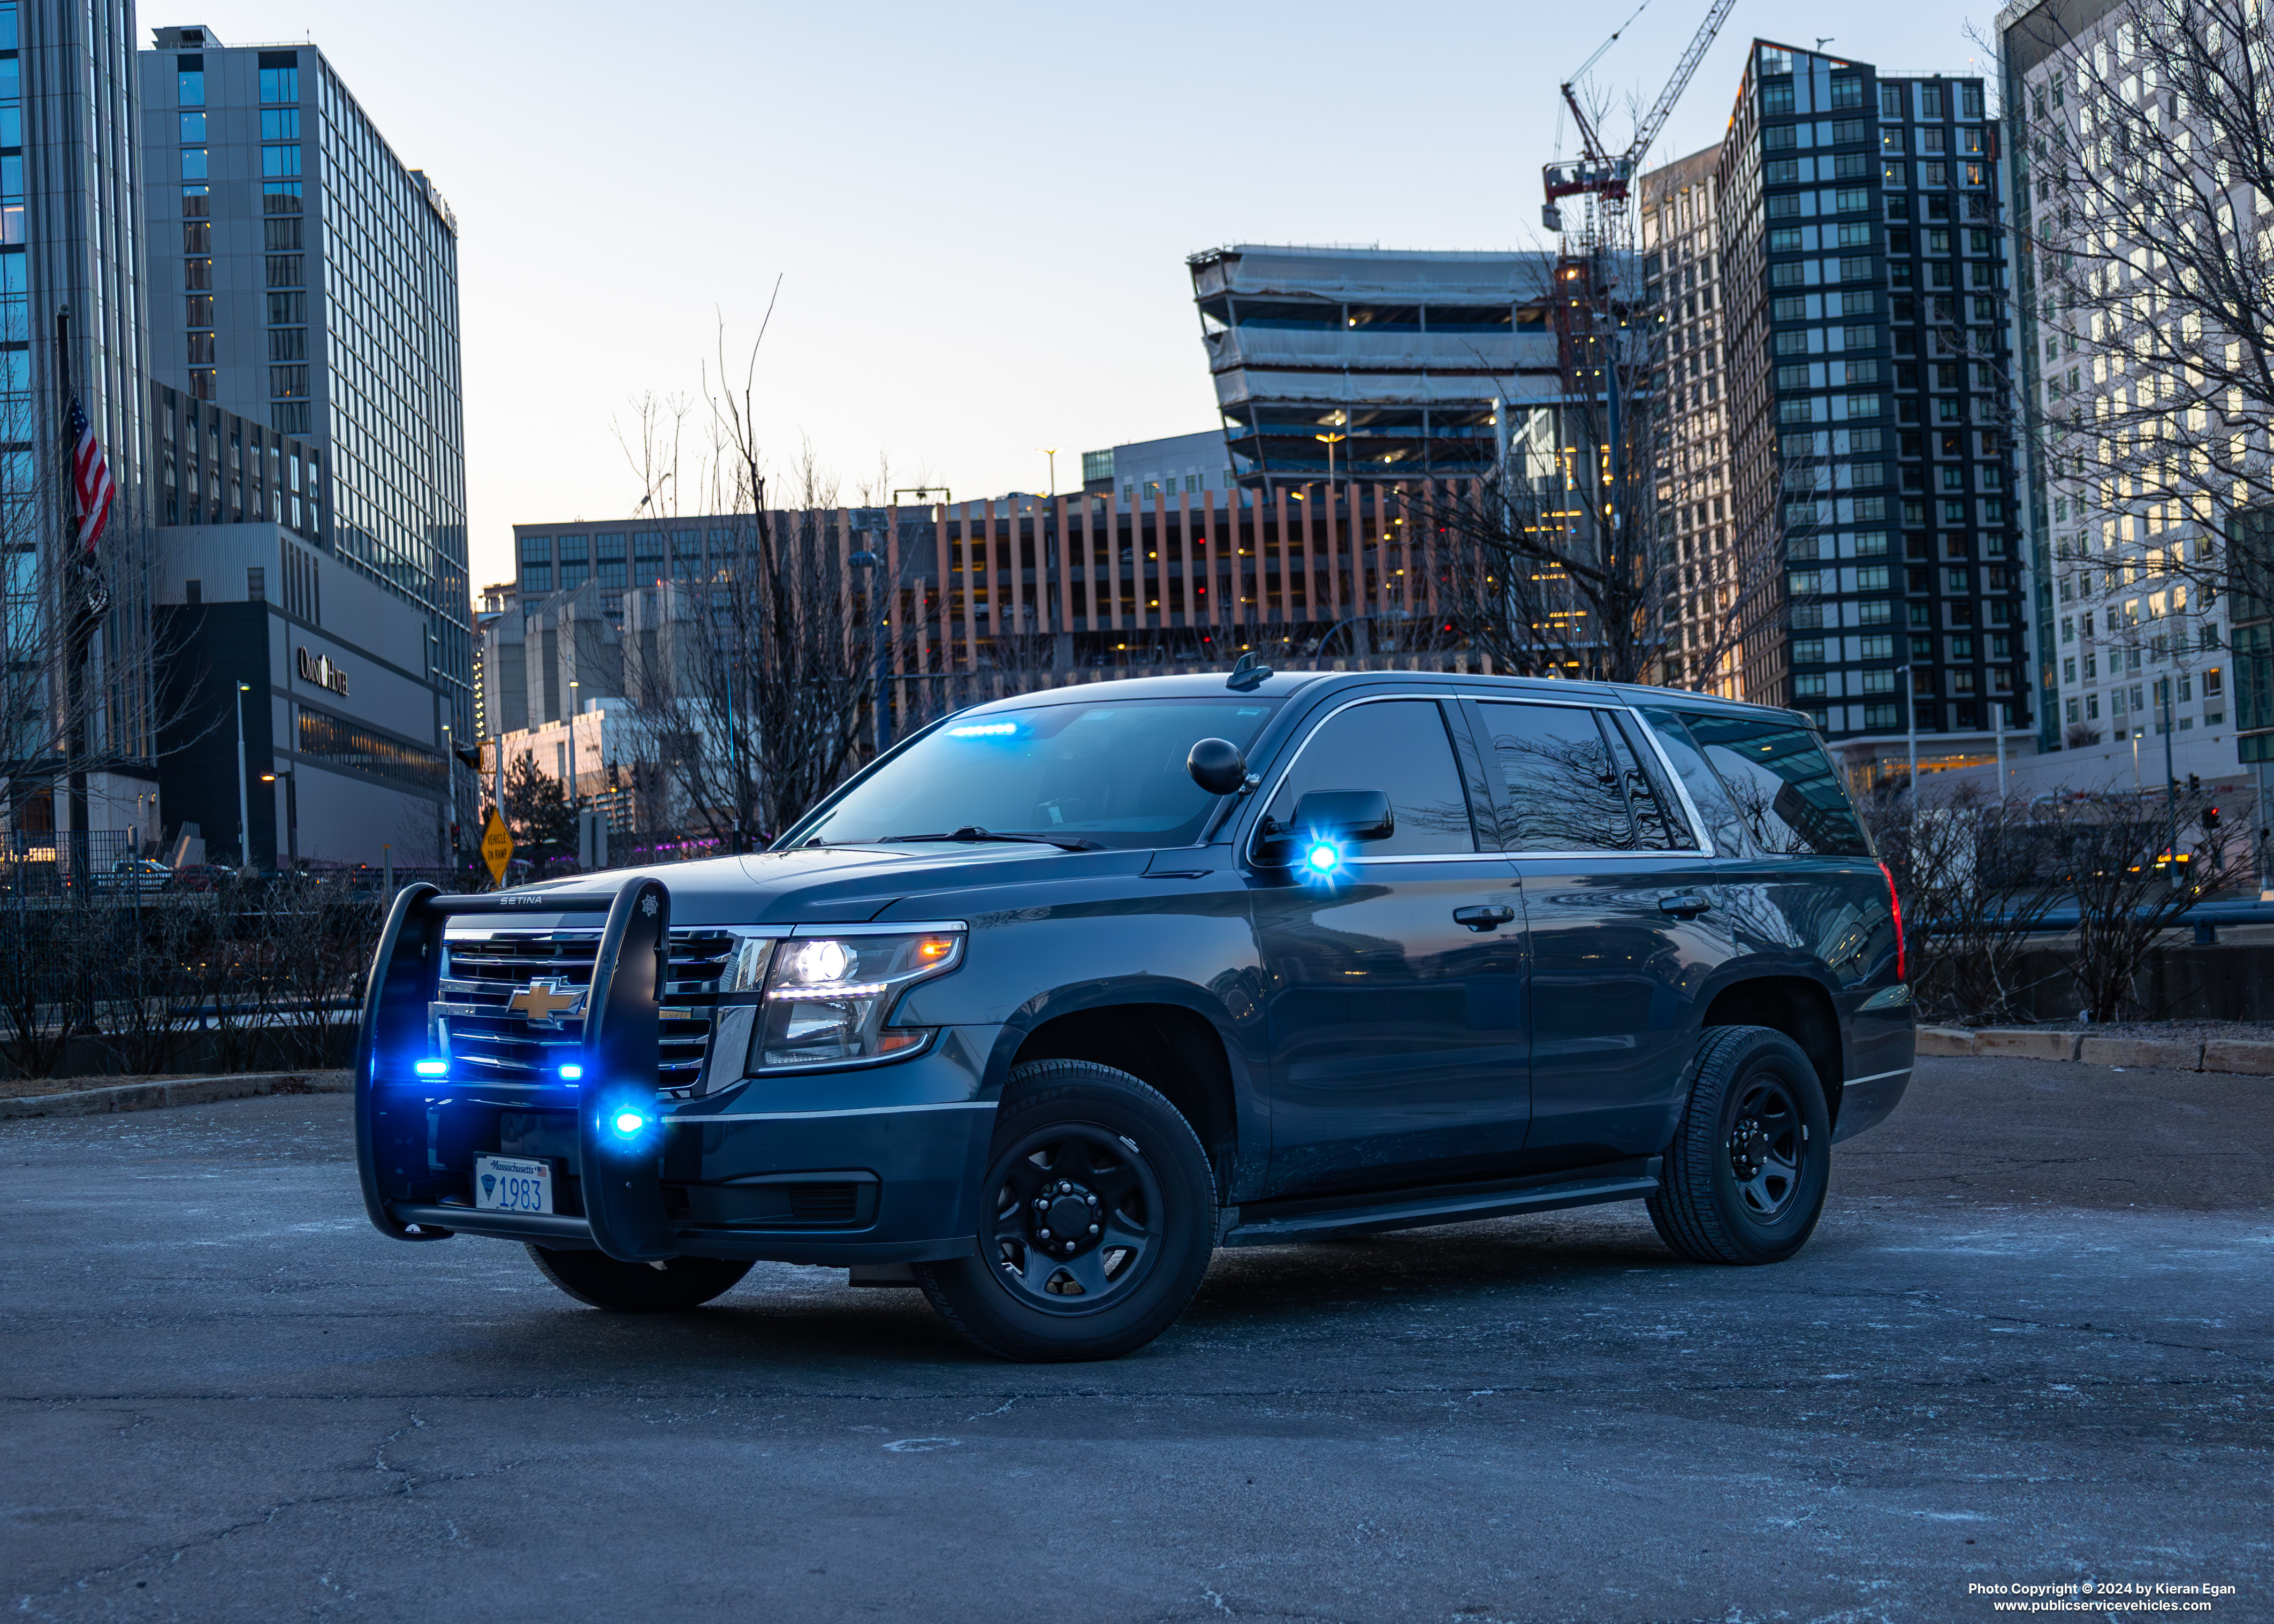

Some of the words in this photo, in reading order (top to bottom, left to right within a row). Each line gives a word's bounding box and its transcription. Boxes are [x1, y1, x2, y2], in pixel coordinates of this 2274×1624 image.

[301, 645, 321, 684] OMNI
[328, 658, 349, 696] HOTEL
[488, 832, 507, 845] VEHICLE
[488, 849, 494, 861] ON
[495, 848, 507, 860] RAMP
[500, 896, 542, 905] SETINA
[492, 1160, 534, 1175] Massachusetts
[499, 1176, 541, 1211] 1983
